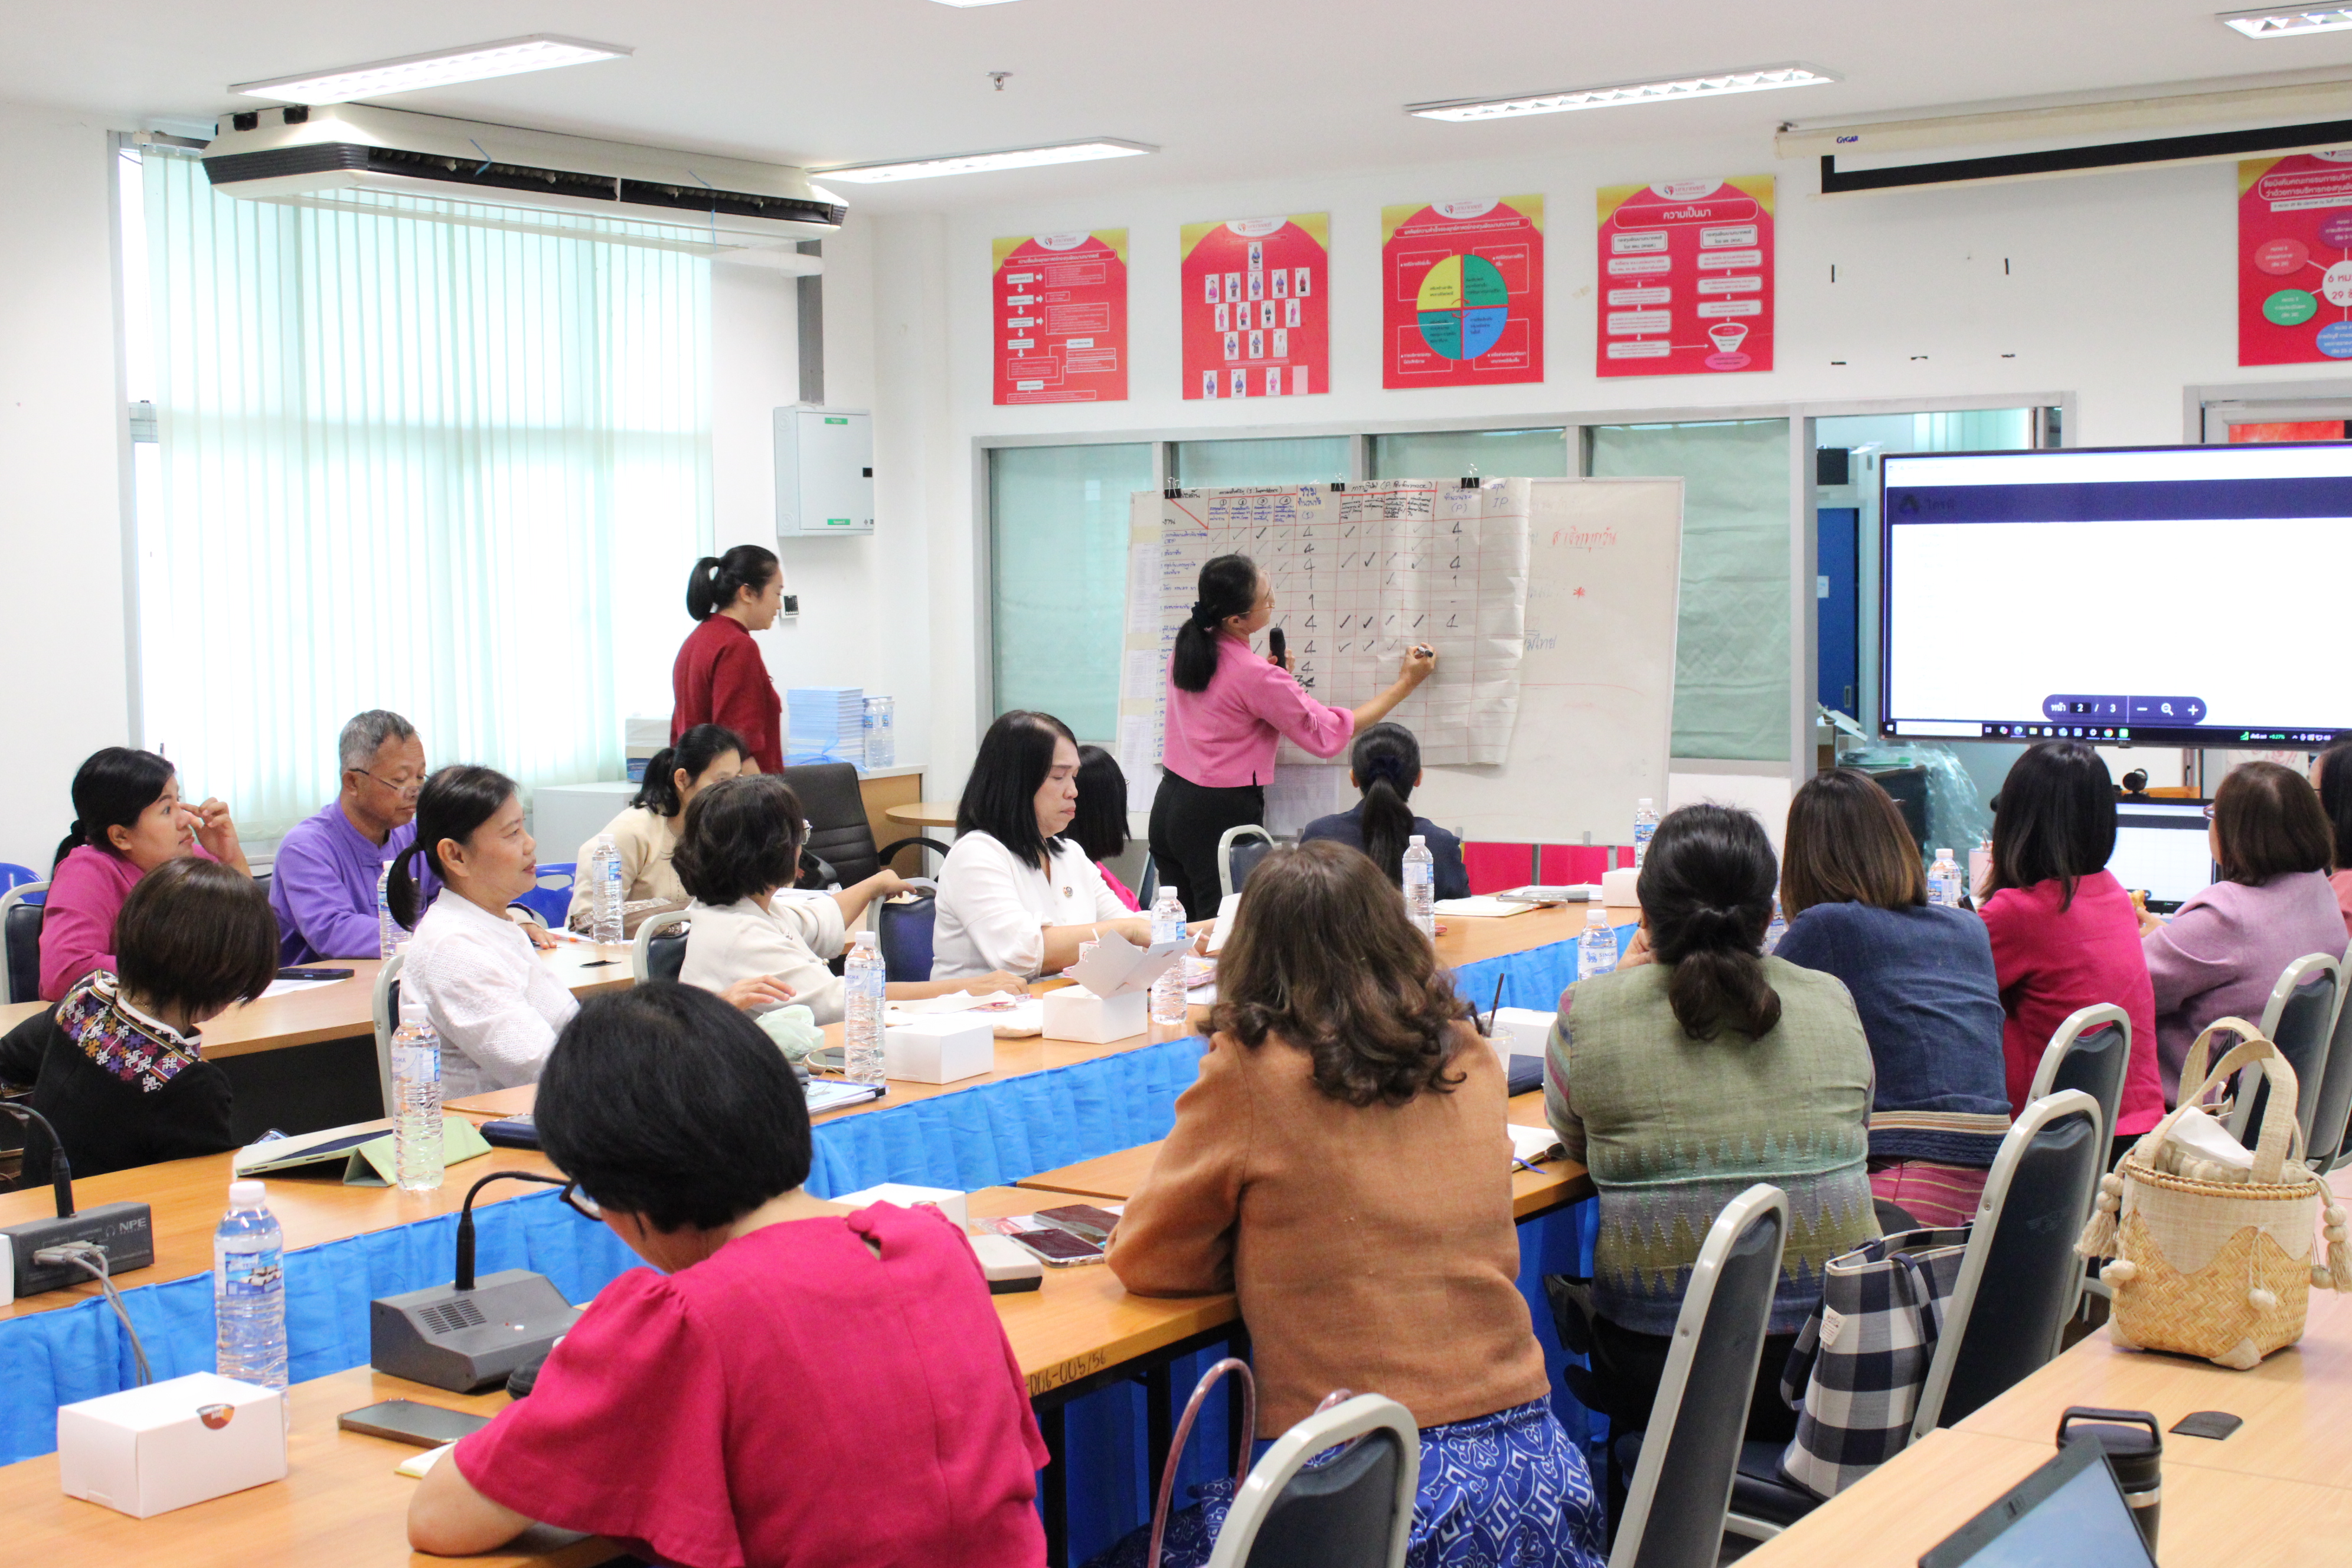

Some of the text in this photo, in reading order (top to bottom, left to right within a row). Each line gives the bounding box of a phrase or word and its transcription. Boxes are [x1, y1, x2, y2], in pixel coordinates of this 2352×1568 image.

[1663, 207, 1711, 219] ความเป็นมา
[2328, 275, 2334, 283] 6
[2332, 291, 2344, 300] 29
[1299, 487, 1317, 497] รวม
[1451, 502, 1468, 514] (P)
[1492, 497, 1509, 509] IP
[1303, 525, 1313, 537] 4
[1452, 521, 1462, 535] 4
[1304, 543, 1314, 554] 4
[1304, 558, 1315, 571] 4
[1449, 556, 1461, 571] 4
[1304, 615, 1317, 633] 4
[1446, 614, 1458, 629] 4
[1304, 640, 1317, 654] 4
[1301, 661, 1314, 674] 4
[2050, 702, 2066, 711] หน้า
[2110, 704, 2116, 713] 3
[119, 1217, 147, 1231] NPE
